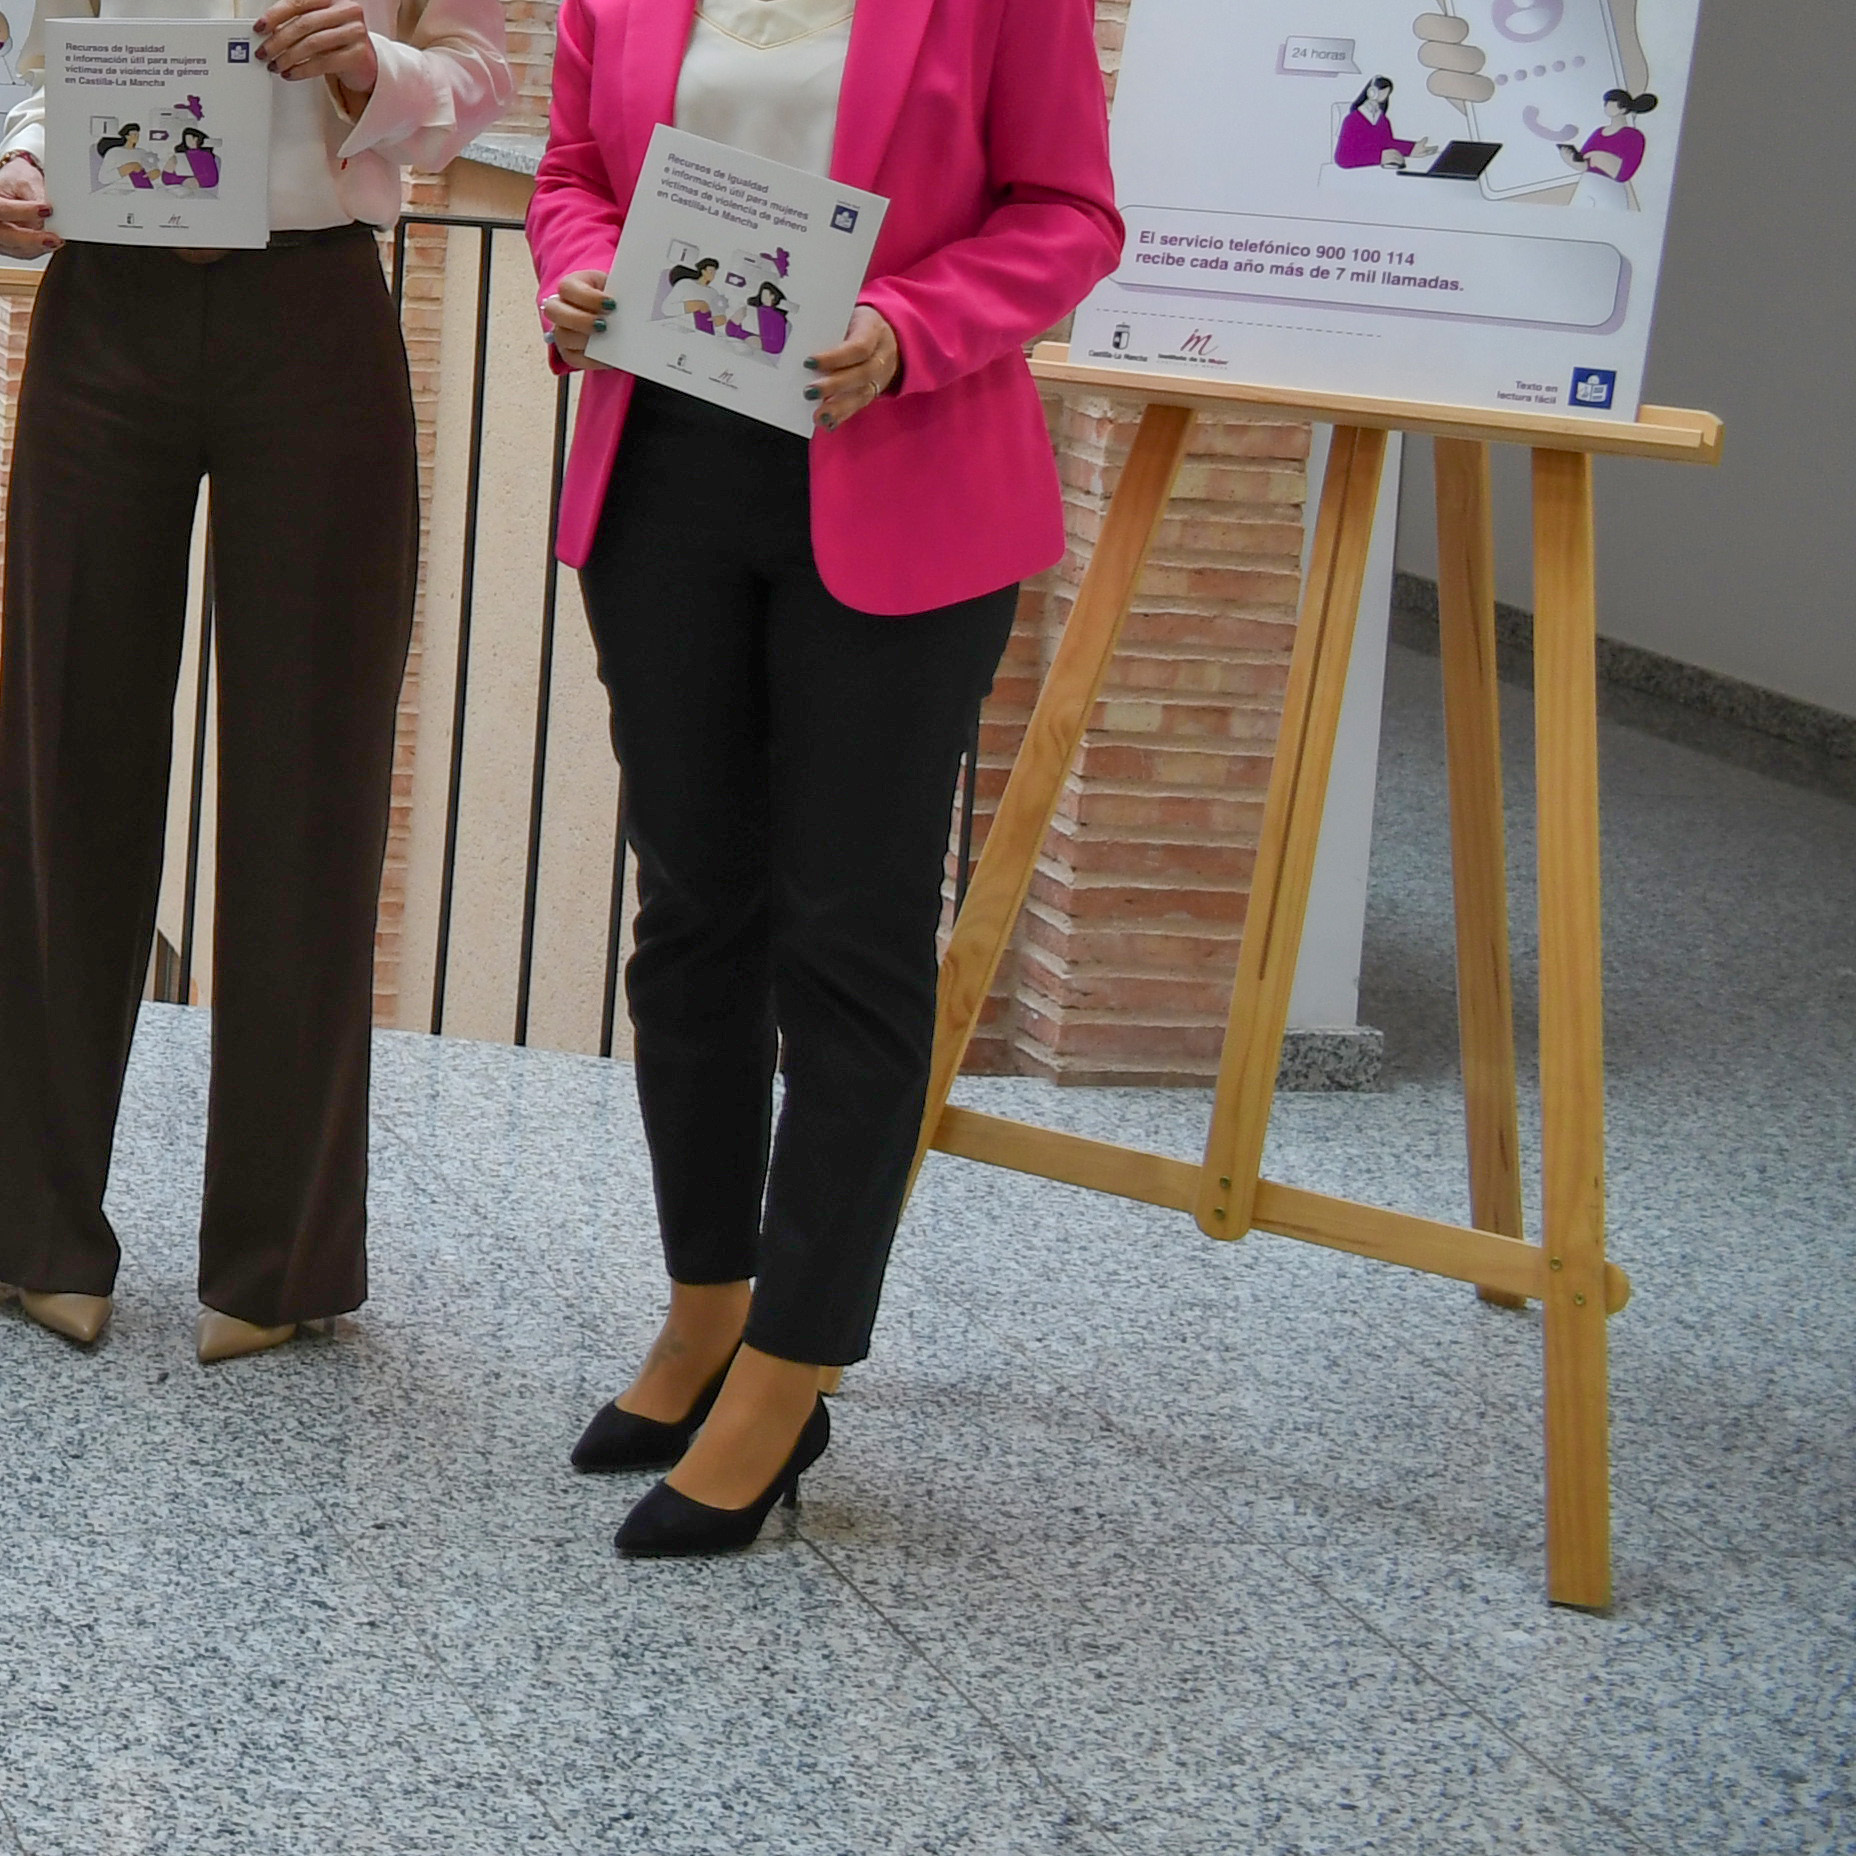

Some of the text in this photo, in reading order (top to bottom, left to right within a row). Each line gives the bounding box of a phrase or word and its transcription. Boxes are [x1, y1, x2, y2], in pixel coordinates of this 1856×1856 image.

[1291, 47, 1348, 61] 24 horas
[1139, 230, 1415, 266] El servicio telefónico 900 100 114
[1135, 252, 1464, 292] recibe cada año más de 7 mil llamadas.
[1515, 380, 1559, 393] Texto en
